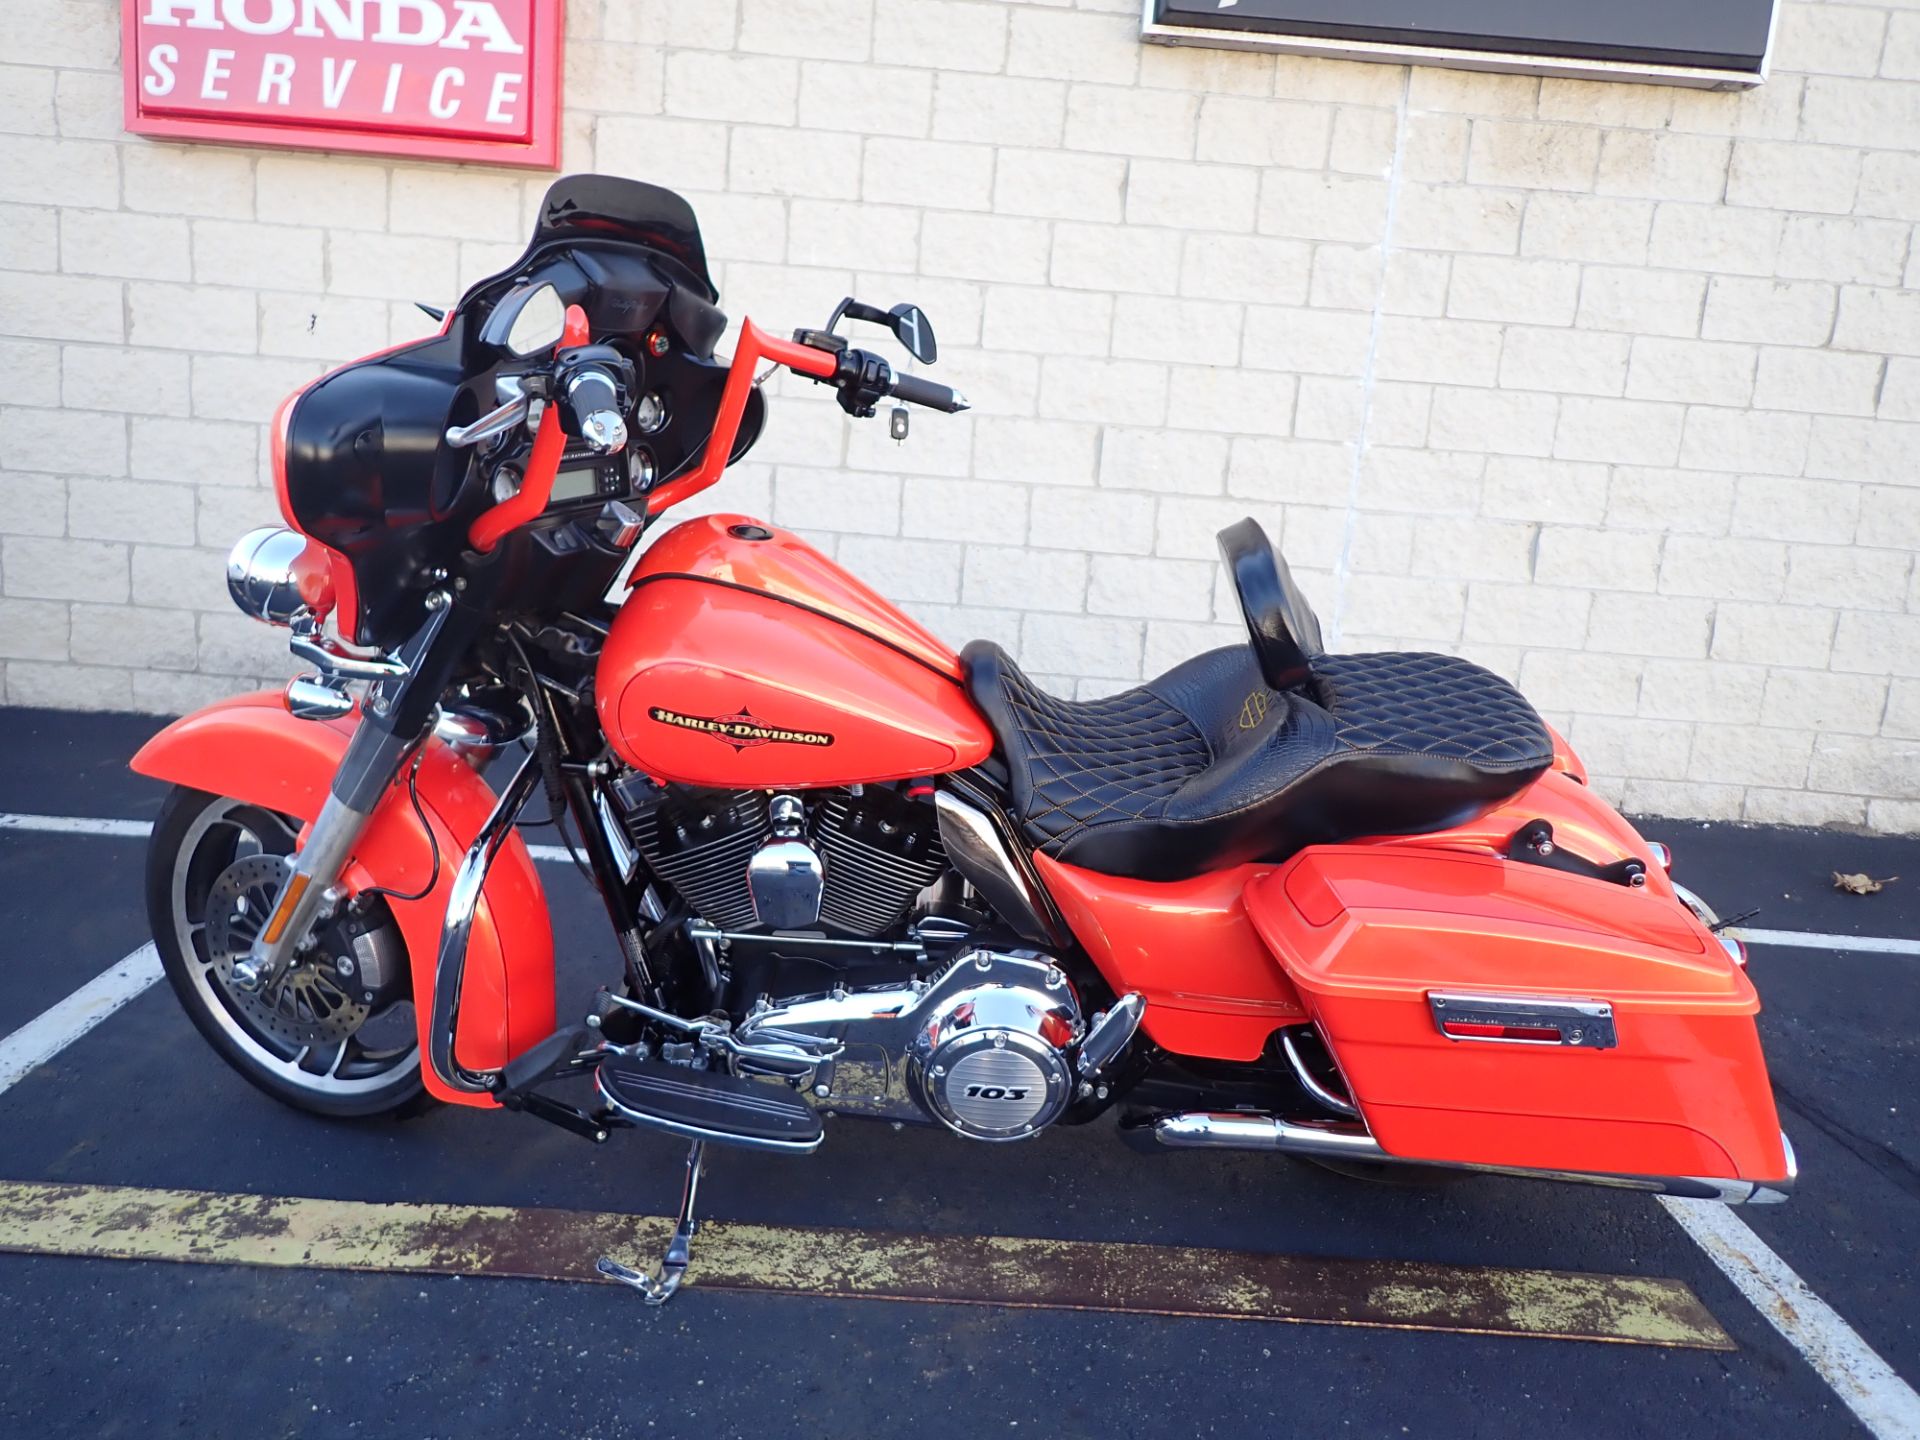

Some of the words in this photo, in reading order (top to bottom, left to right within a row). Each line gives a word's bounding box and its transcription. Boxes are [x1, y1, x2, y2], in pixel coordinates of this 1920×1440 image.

[143, 0, 524, 54] HONDA
[143, 43, 524, 124] SERVICE
[964, 1084, 1031, 1101] 103
